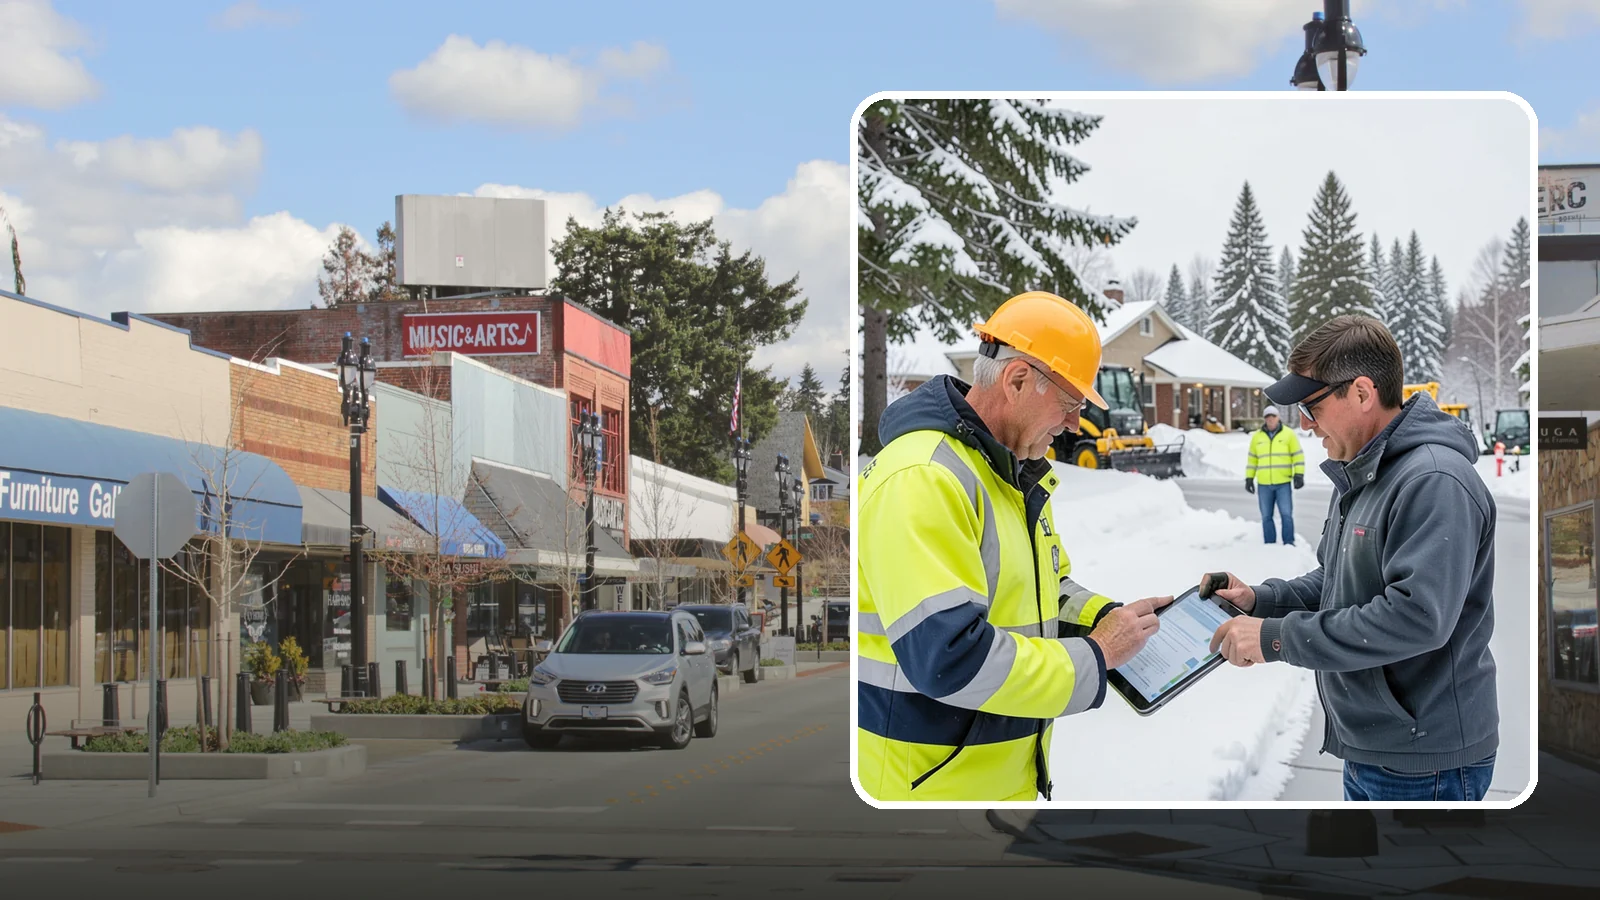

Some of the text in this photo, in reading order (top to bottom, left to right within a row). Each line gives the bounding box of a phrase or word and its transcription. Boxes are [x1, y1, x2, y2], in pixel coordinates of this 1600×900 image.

[409, 323, 519, 348] MUSIC&ARTS
[0, 472, 121, 519] Furniture Gal
[454, 563, 479, 573] SUSHI
